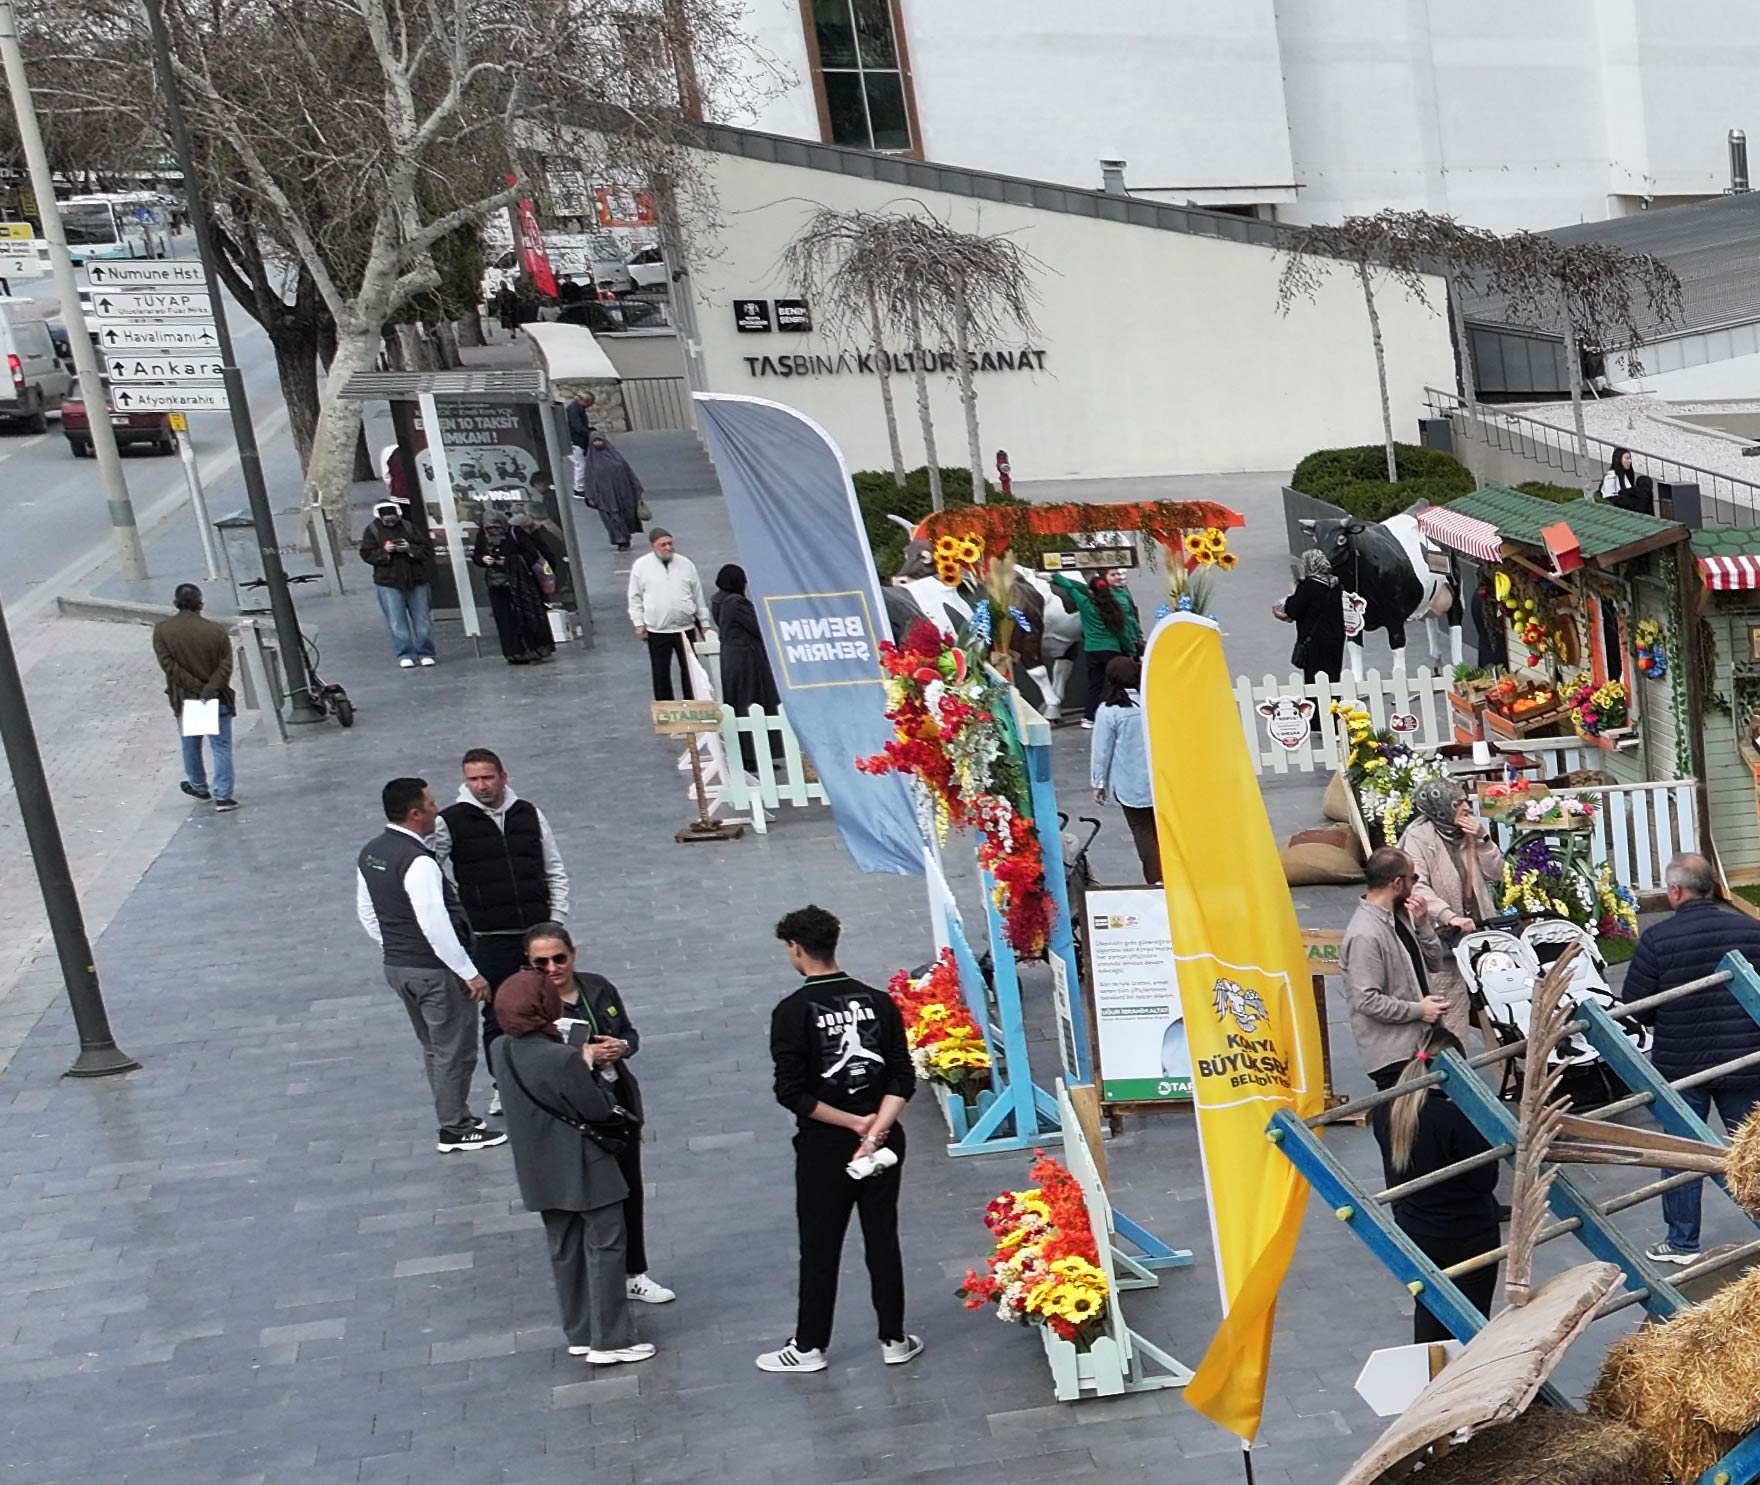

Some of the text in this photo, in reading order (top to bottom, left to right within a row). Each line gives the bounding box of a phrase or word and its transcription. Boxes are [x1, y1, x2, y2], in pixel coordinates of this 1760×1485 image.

[108, 267, 170, 280] Numune
[133, 294, 191, 307] TÜYAP
[123, 330, 197, 343] Havalimanı
[133, 360, 224, 376] Ankara
[966, 350, 1047, 373] SANAT
[413, 413, 520, 431] EEN 10 TAKSİT
[816, 1007, 876, 1029] JORDAN
[1170, 1082, 1194, 1092] TAR
